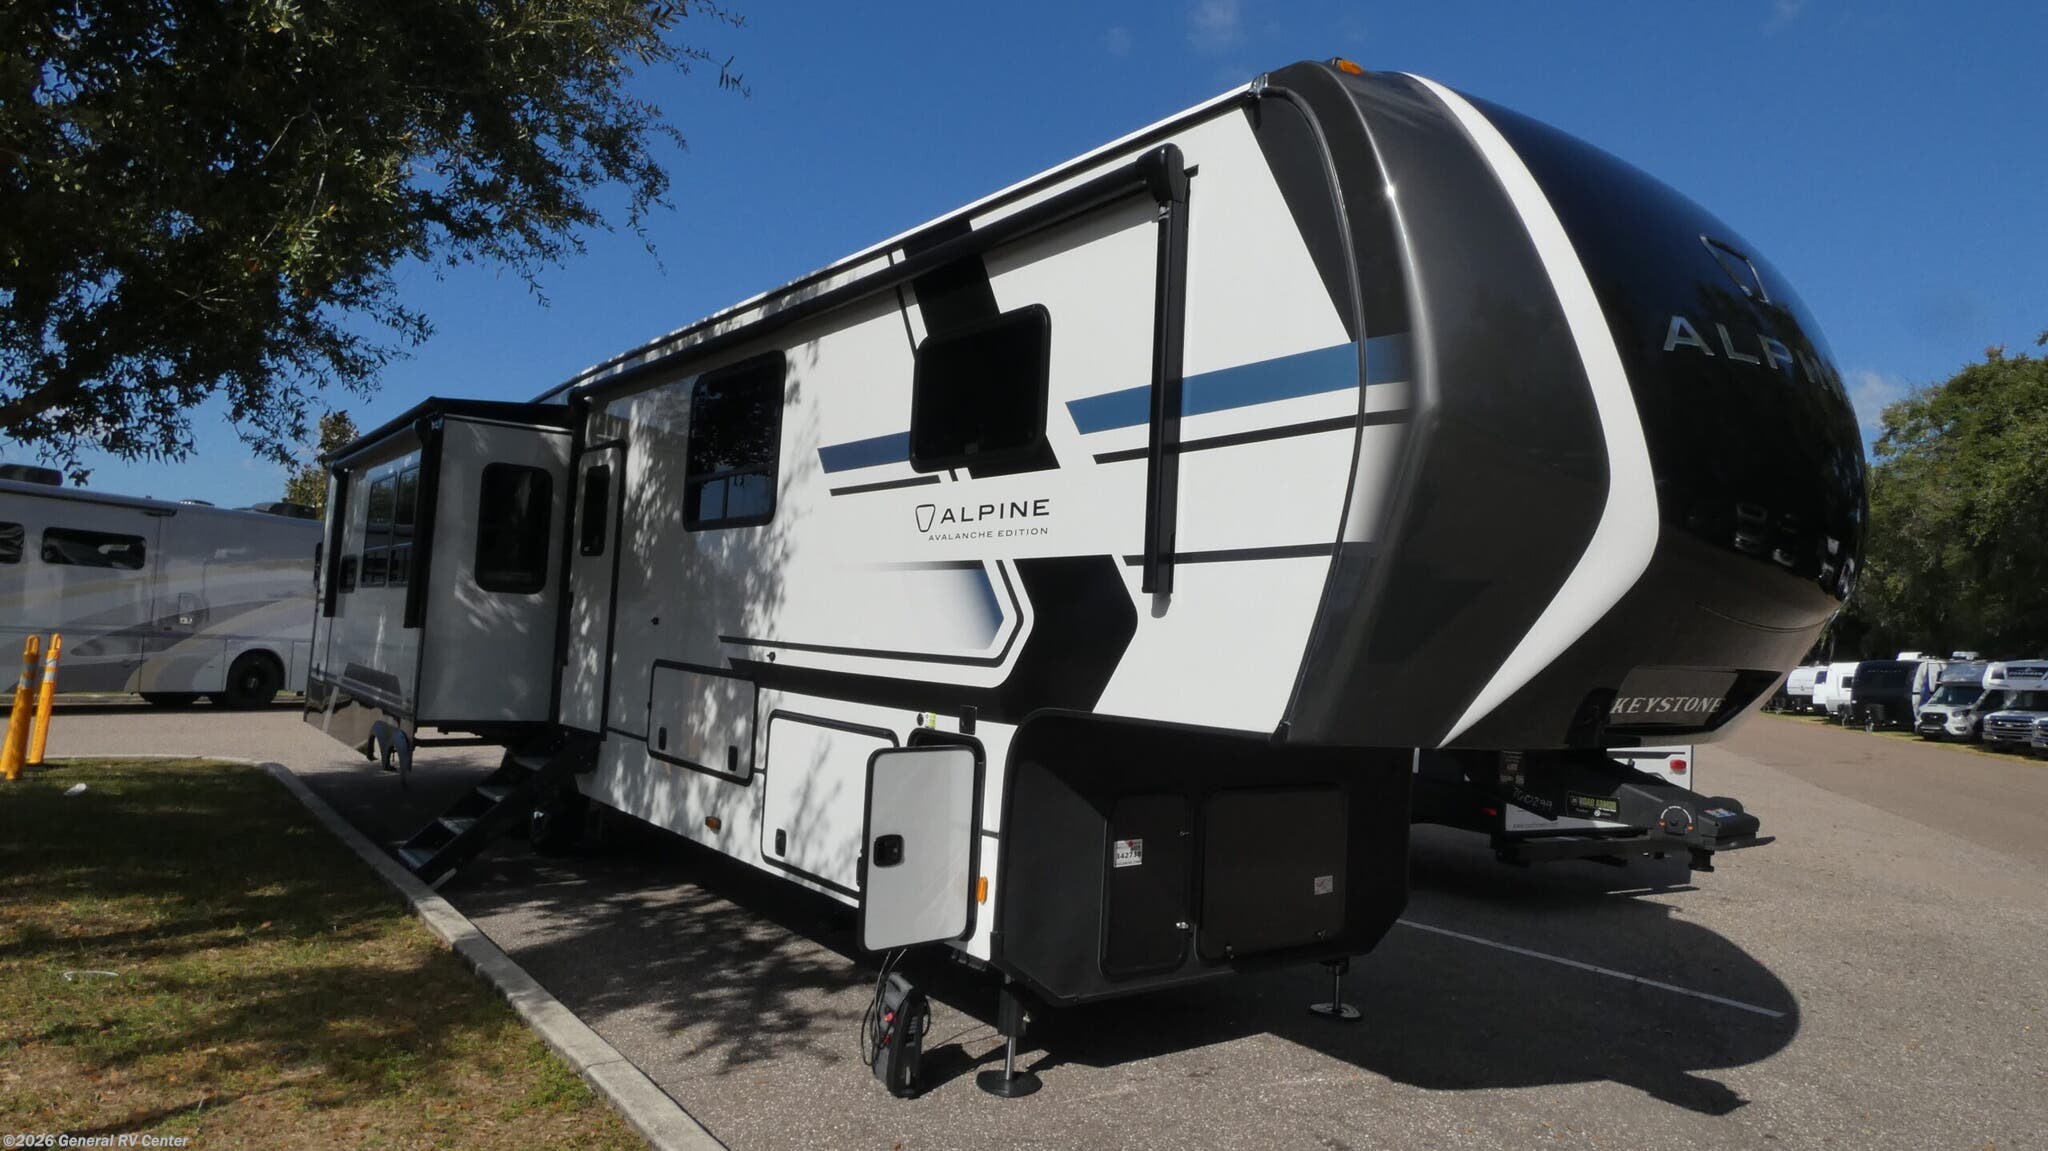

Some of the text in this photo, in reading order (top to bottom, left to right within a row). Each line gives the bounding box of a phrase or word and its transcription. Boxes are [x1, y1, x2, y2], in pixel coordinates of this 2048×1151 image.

[1663, 315, 1848, 405] ALPIN
[940, 498, 1050, 524] ALPINE
[928, 527, 1049, 542] AVALANCHE EDITION
[1609, 696, 1726, 714] KEYSTONE
